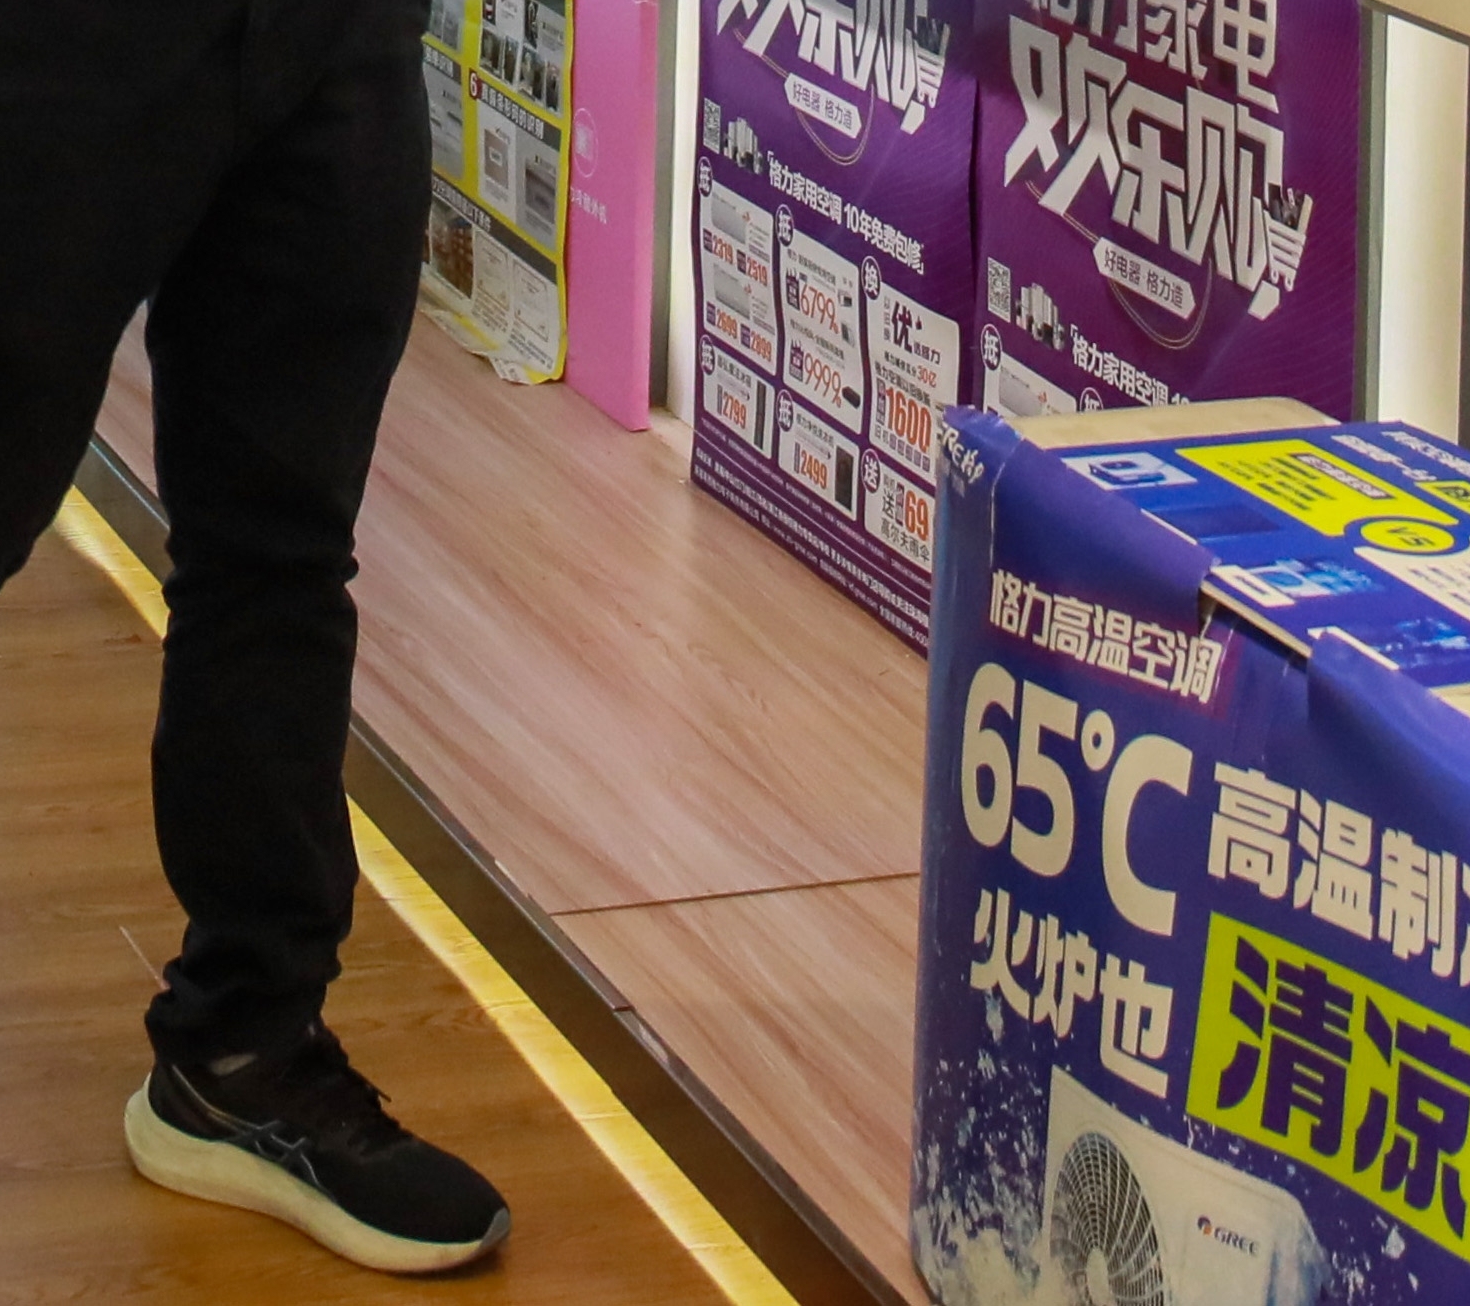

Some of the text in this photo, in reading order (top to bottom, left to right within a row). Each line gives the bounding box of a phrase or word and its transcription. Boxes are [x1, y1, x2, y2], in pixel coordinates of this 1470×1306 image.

[1004, 15, 1313, 321] 欢乐购
[800, 284, 835, 330] 6799
[804, 352, 841, 397] 9999
[723, 392, 747, 429] 2799
[887, 387, 931, 452] 1600
[801, 449, 827, 489] 2499
[905, 489, 928, 541] 69
[990, 569, 1222, 704] 格力高温空调
[970, 888, 1175, 1099] 火炉也
[1213, 1220, 1259, 1255] GREE
